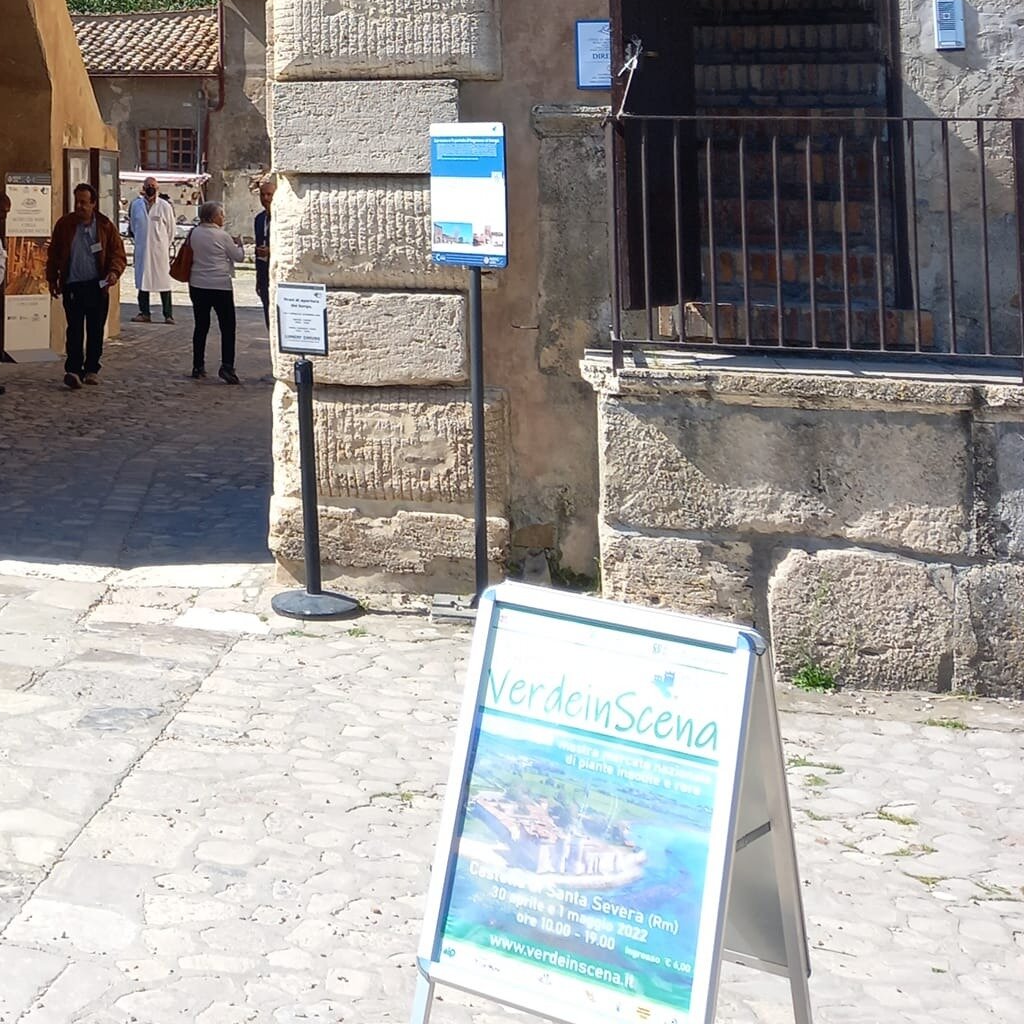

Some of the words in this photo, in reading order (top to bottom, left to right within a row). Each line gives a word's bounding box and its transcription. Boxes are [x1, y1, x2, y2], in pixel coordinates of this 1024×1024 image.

[487, 666, 719, 751] VerdeinScena
[491, 885, 506, 901] 30
[616, 921, 649, 943] 2022
[516, 911, 537, 928] ore
[541, 916, 572, 938] 10.00
[584, 929, 616, 951] 19.00
[544, 884, 588, 908] Santa
[592, 895, 645, 924] Severa
[648, 913, 679, 936] (Rm)
[489, 934, 636, 990] www.verdeinscena.it
